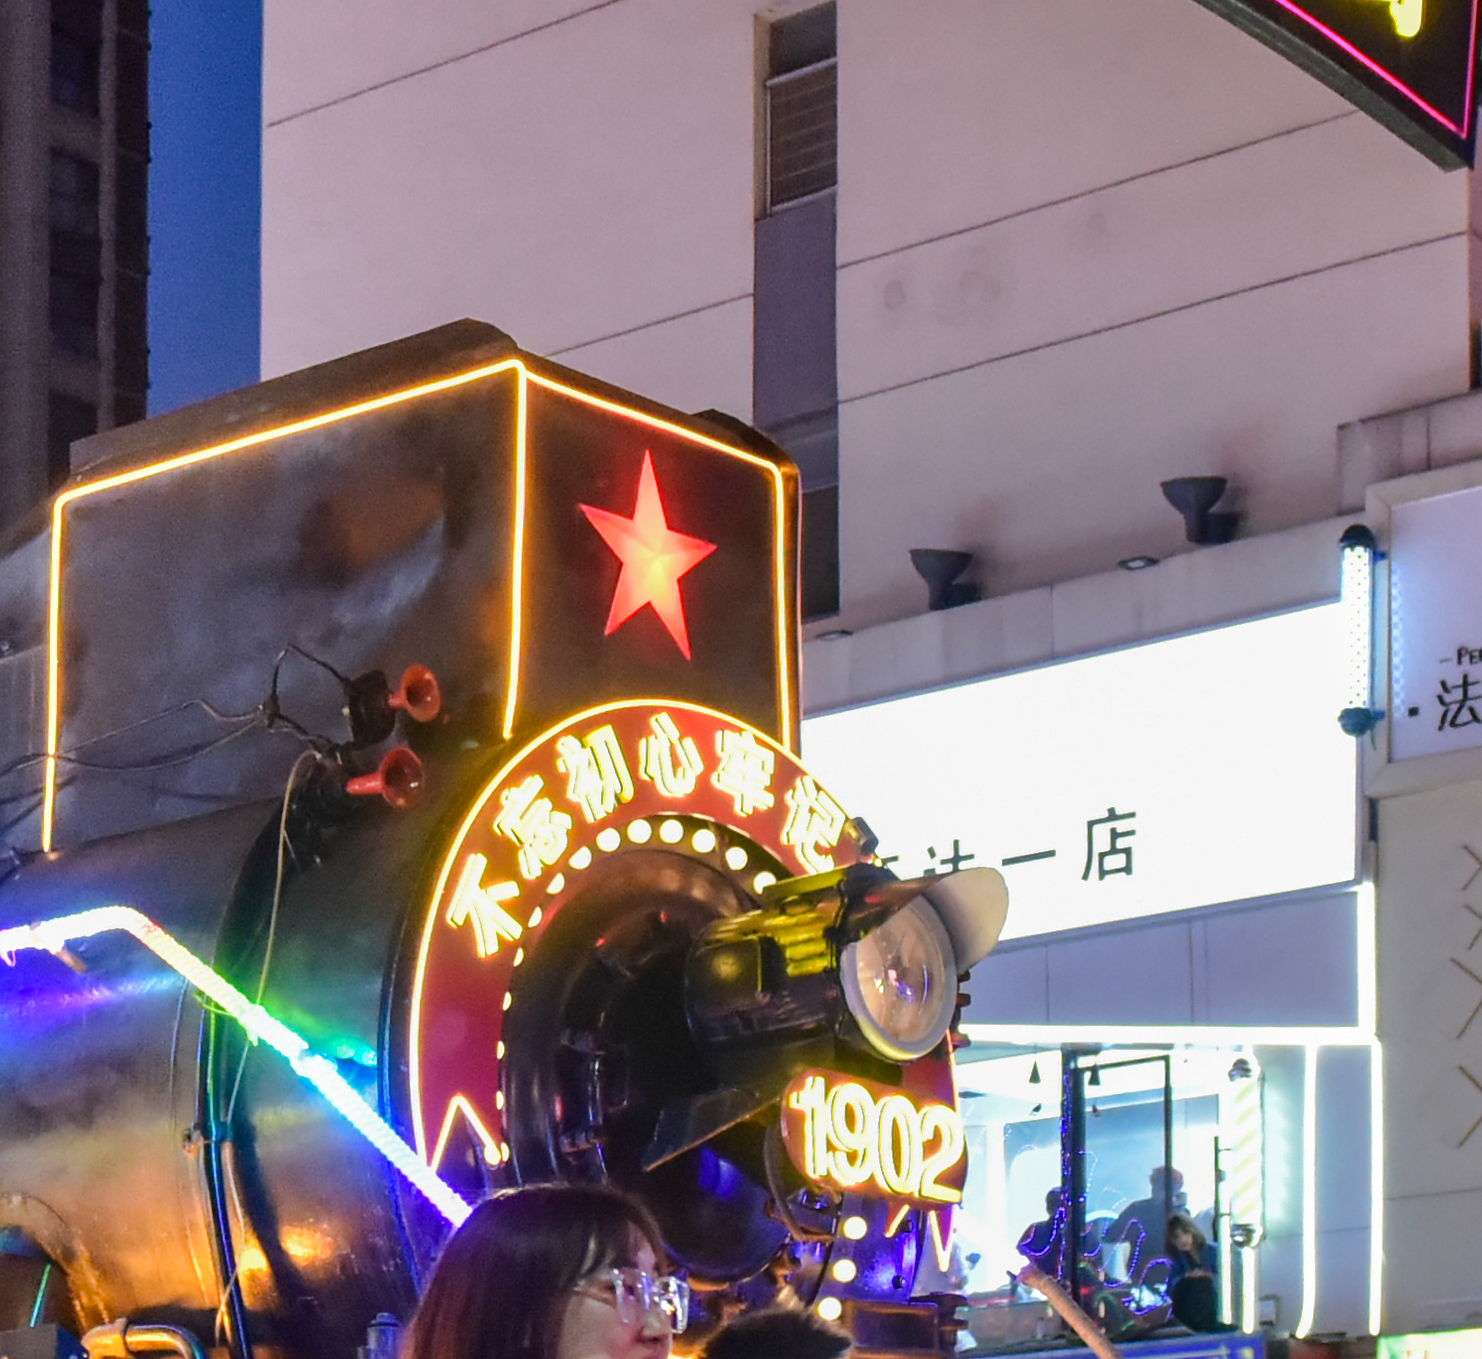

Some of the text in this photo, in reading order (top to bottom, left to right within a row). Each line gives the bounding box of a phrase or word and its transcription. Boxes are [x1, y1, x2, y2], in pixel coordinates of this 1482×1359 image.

[444, 710, 846, 960] 不忘初心牢记
[789, 1075, 966, 1204] 1902
